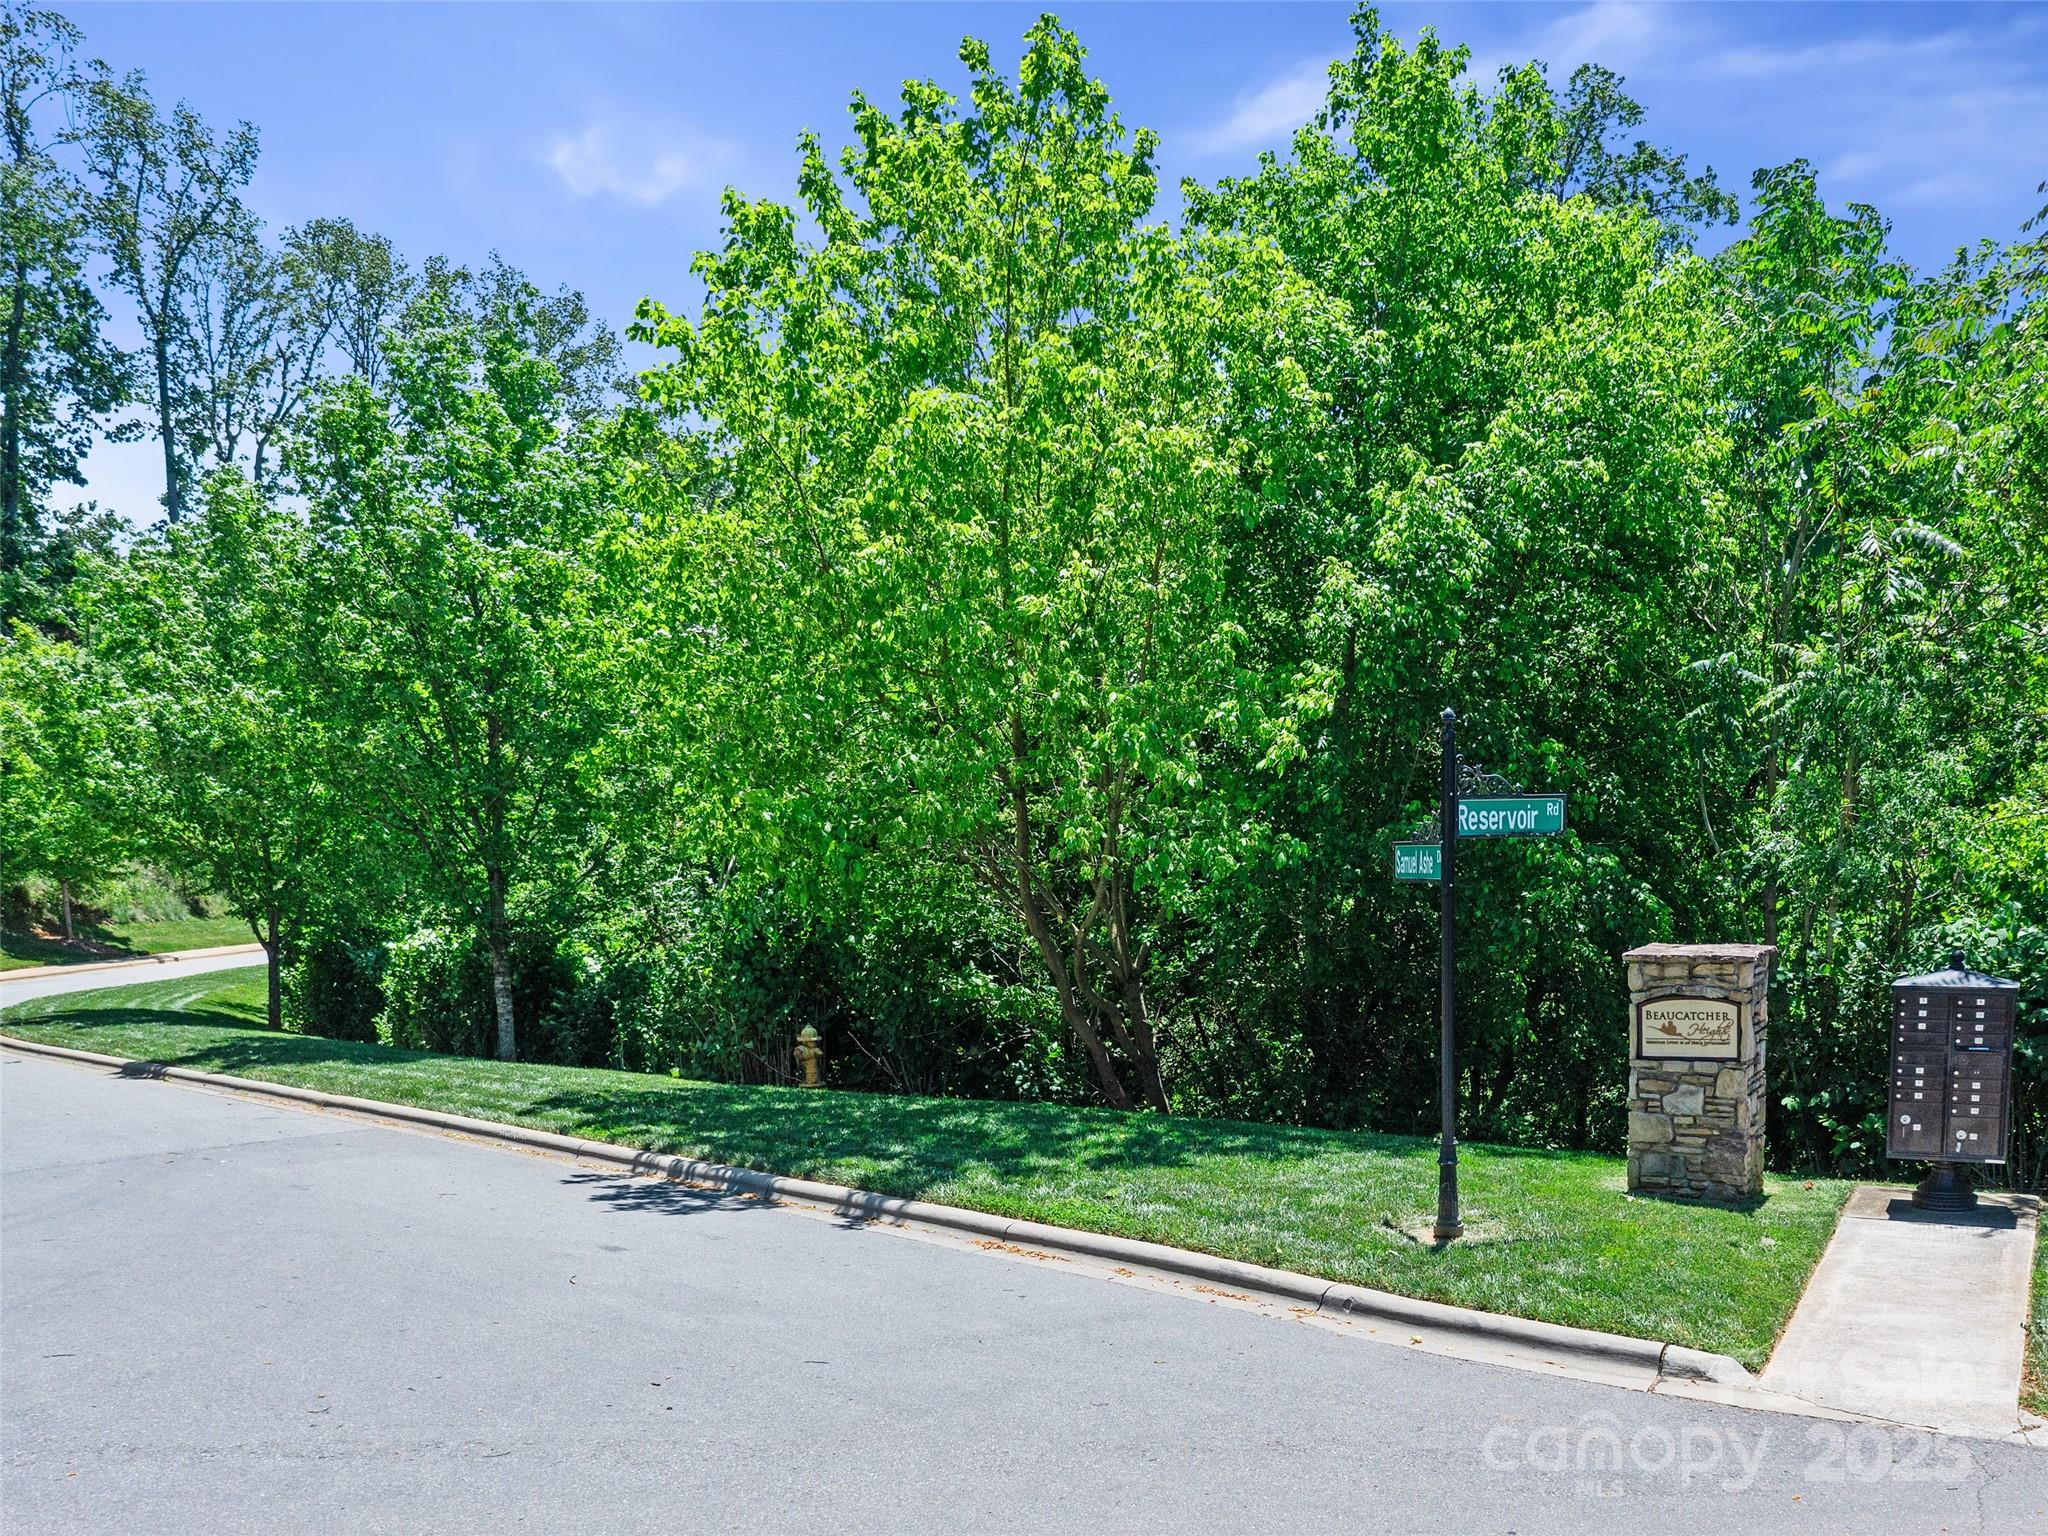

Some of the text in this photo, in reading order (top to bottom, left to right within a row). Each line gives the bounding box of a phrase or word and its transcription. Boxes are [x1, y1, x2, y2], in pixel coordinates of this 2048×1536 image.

[1458, 802, 1560, 831] Reservoir Rd
[1396, 849, 1418, 875] Samuel
[1419, 849, 1434, 875] Ashe
[1645, 1010, 1730, 1021] BEAUCATCHER
